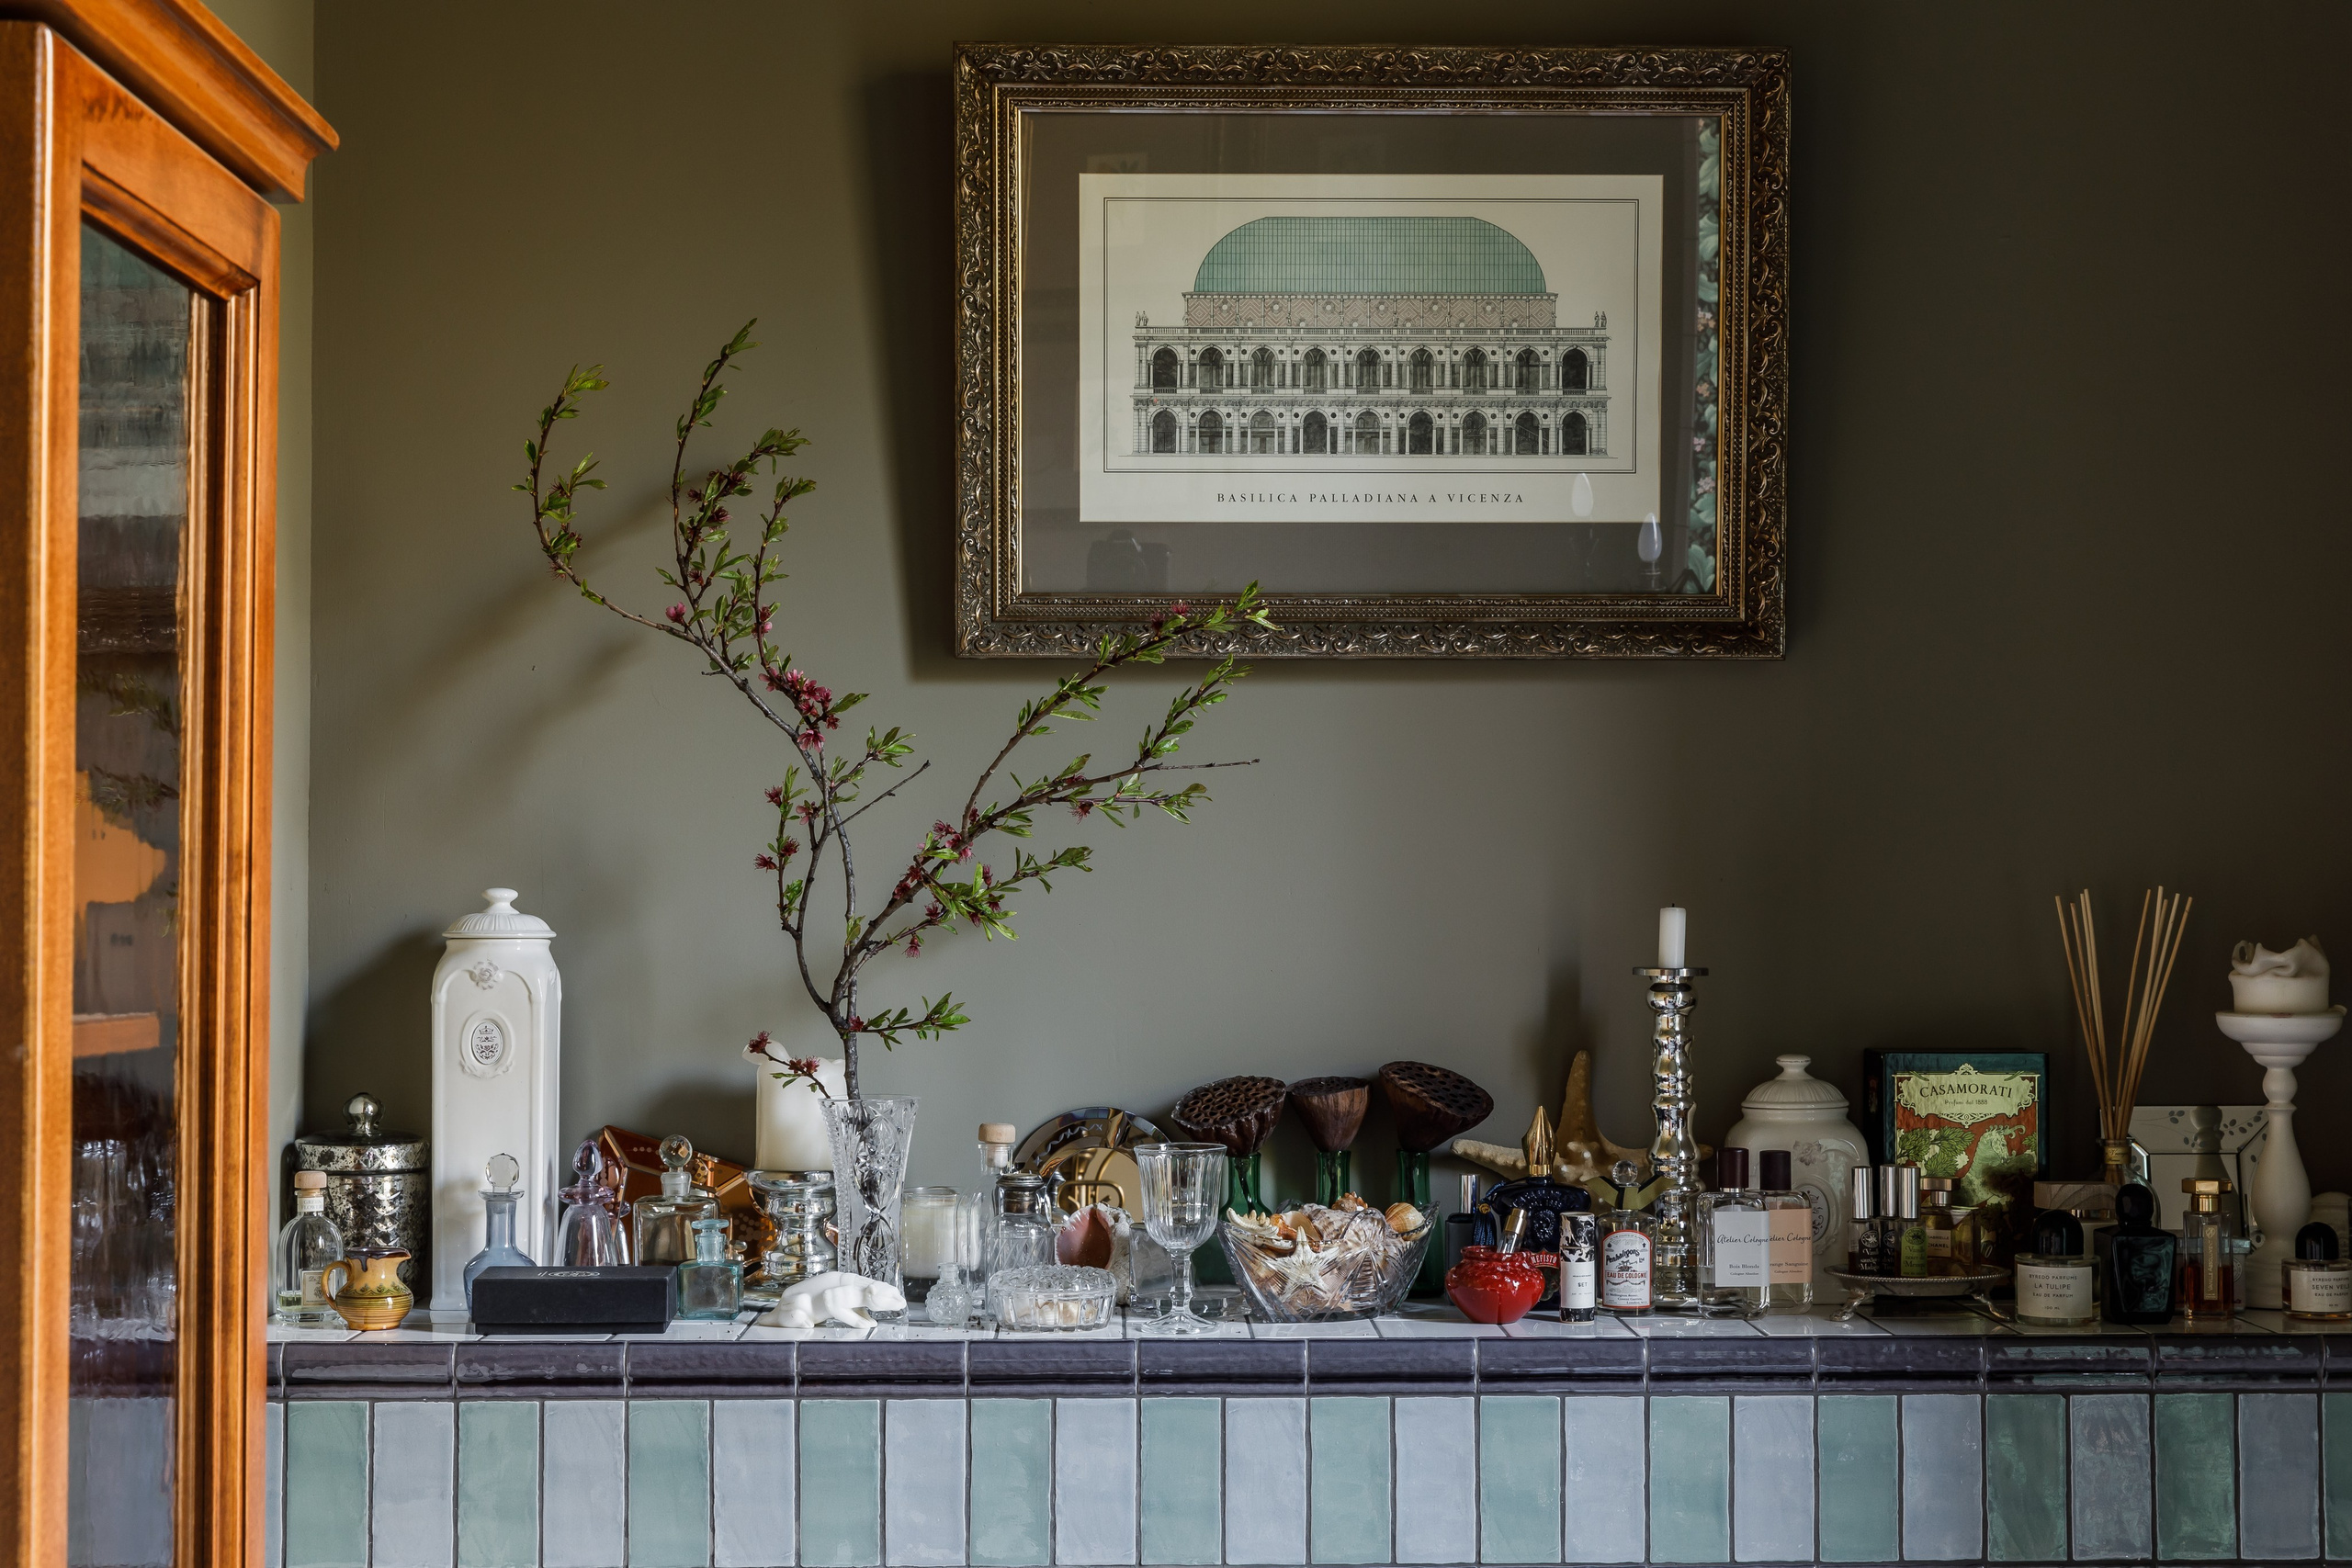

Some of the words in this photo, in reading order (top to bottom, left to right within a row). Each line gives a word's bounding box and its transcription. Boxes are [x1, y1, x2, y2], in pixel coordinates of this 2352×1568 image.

[1217, 492, 1298, 503] BASILICA
[1308, 492, 1419, 503] PALLADIANA
[1428, 492, 1438, 503] A
[1447, 492, 1524, 503] VICENZA
[1919, 1083, 2013, 1099] CASAMORATI
[1716, 1234, 1742, 1244] Atelier
[1744, 1234, 1769, 1246] Cologne
[1769, 1235, 1785, 1243] elier
[1786, 1232, 1812, 1245] Cologne
